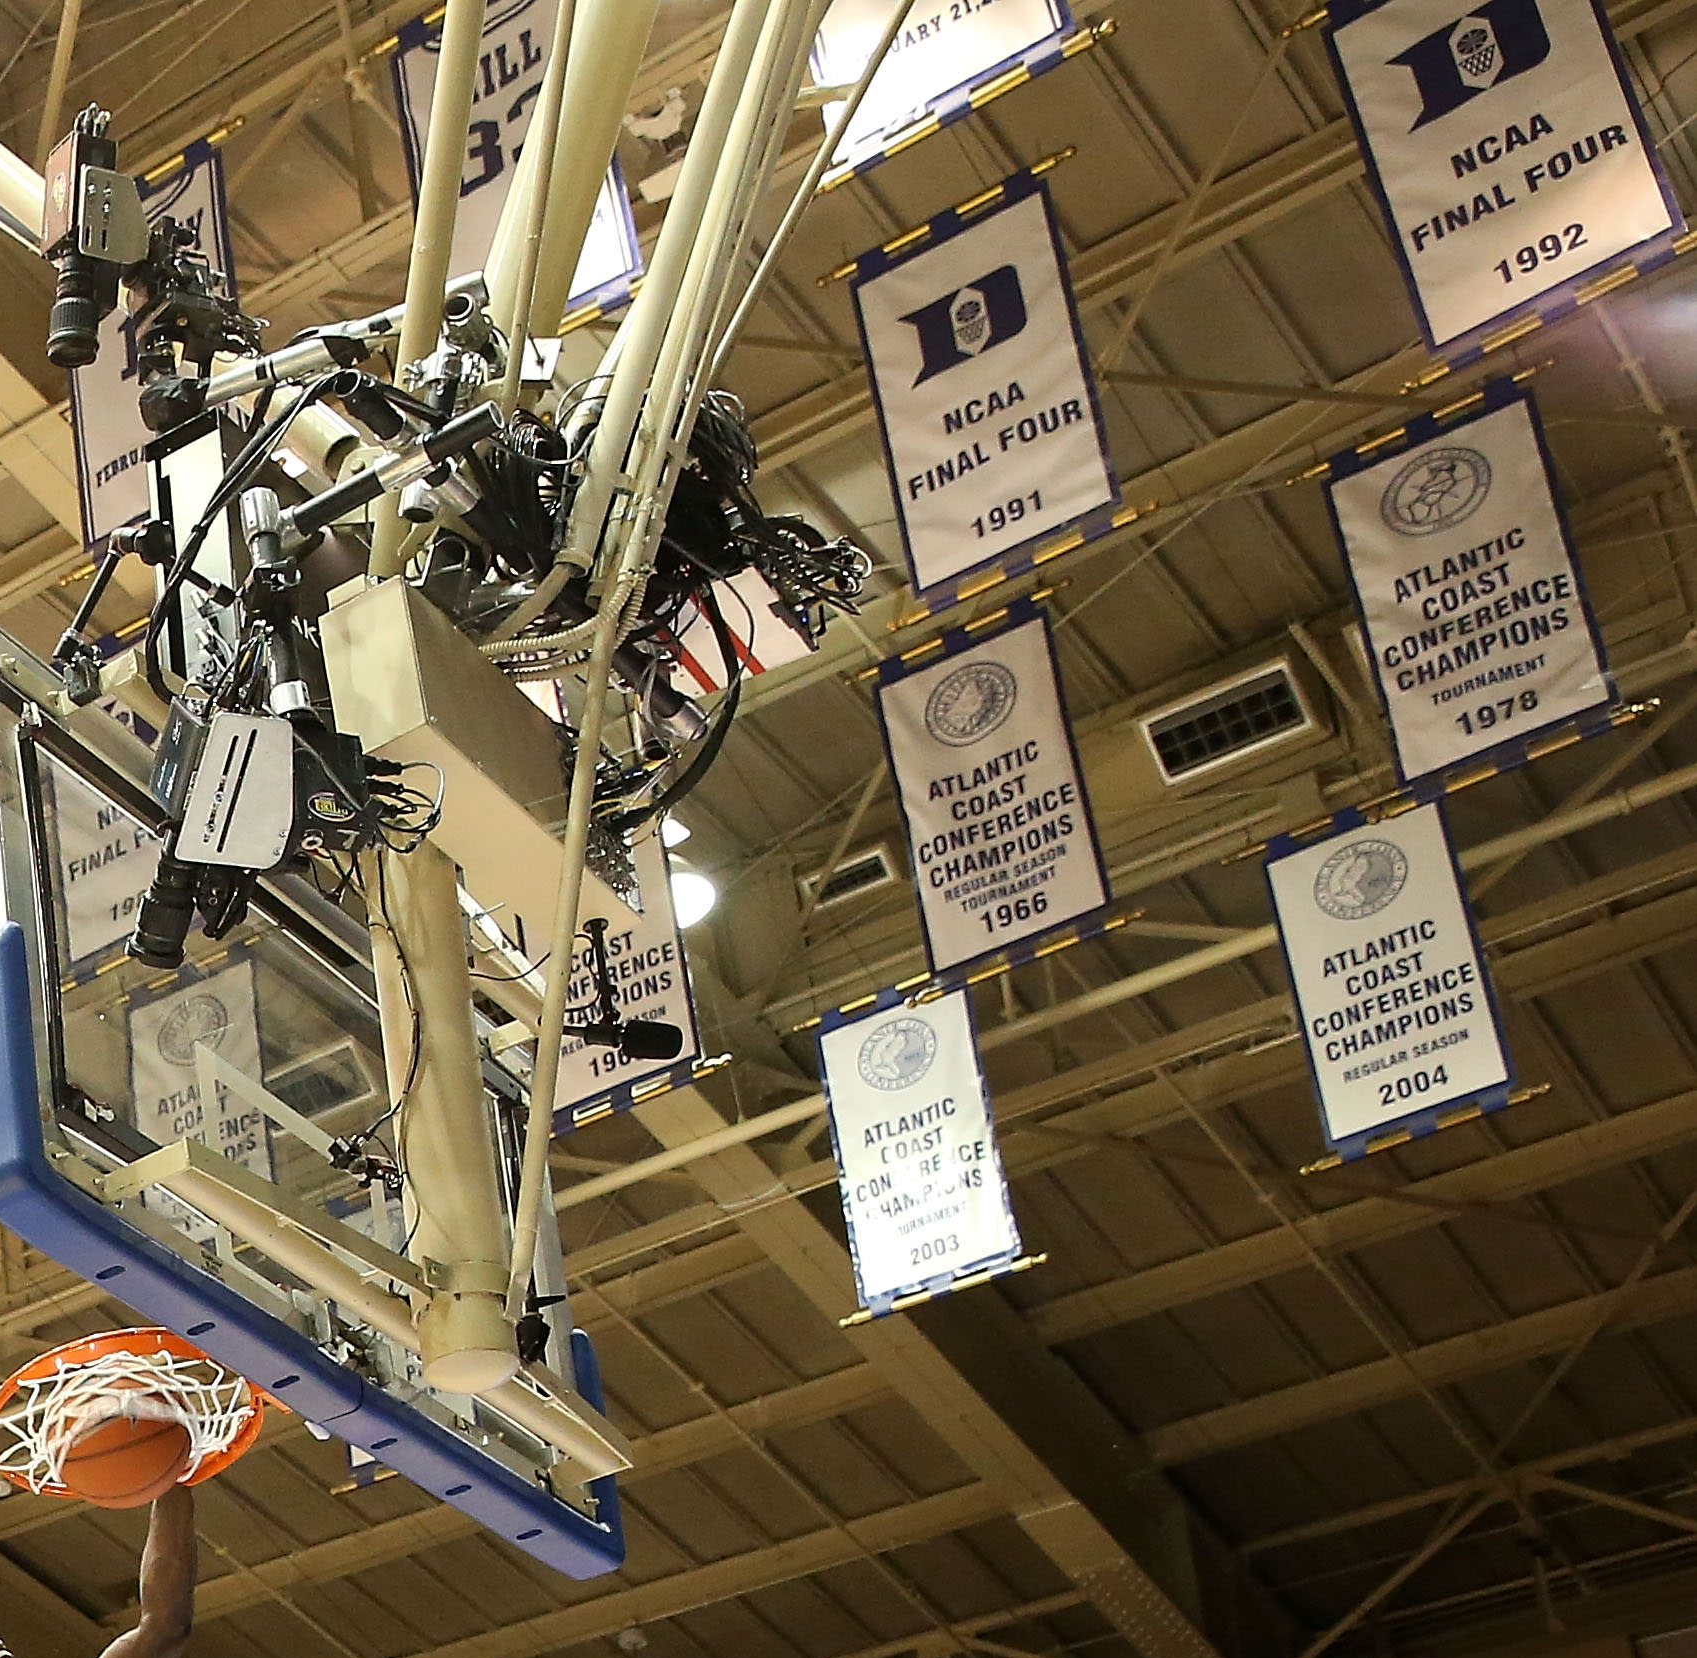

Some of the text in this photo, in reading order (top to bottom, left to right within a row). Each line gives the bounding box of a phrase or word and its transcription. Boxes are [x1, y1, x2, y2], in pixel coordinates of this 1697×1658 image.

[1451, 113, 1554, 180] NCAA
[1411, 124, 1631, 254] FINAL FOUR
[1493, 222, 1590, 286] 1992
[943, 381, 1027, 435] NCAA
[907, 398, 1086, 503] FINAL FOUR
[969, 489, 1046, 541] 1991
[1394, 527, 1526, 604] ATLANTIC
[1420, 562, 1514, 623] COAST
[1382, 572, 1573, 672] CONFERENCE
[1395, 607, 1570, 695] CHAMPIONS
[1431, 654, 1547, 707] TOURNAMENT
[1454, 690, 1542, 740] 1978
[928, 741, 1041, 804] ATLANTIC
[951, 774, 1029, 825] COAST
[917, 783, 1075, 868] CONFERENCE
[929, 814, 1075, 892] CHAMPIONS
[943, 843, 1067, 905] REGULAR SEASON
[959, 866, 1057, 916] TOURNAMENT
[980, 892, 1050, 937] 1966
[1322, 919, 1437, 978] ATLANTIC
[1346, 952, 1424, 997] COAST
[1312, 962, 1476, 1040] CONFERENCE
[1326, 993, 1474, 1063] CHAMPIONS
[1343, 1028, 1470, 1083] REGULAR SEASON
[1378, 1064, 1449, 1108] 2004
[864, 1097, 956, 1148] ATLANTIC
[881, 1126, 944, 1165] COAST
[910, 1233, 960, 1266] 2003
